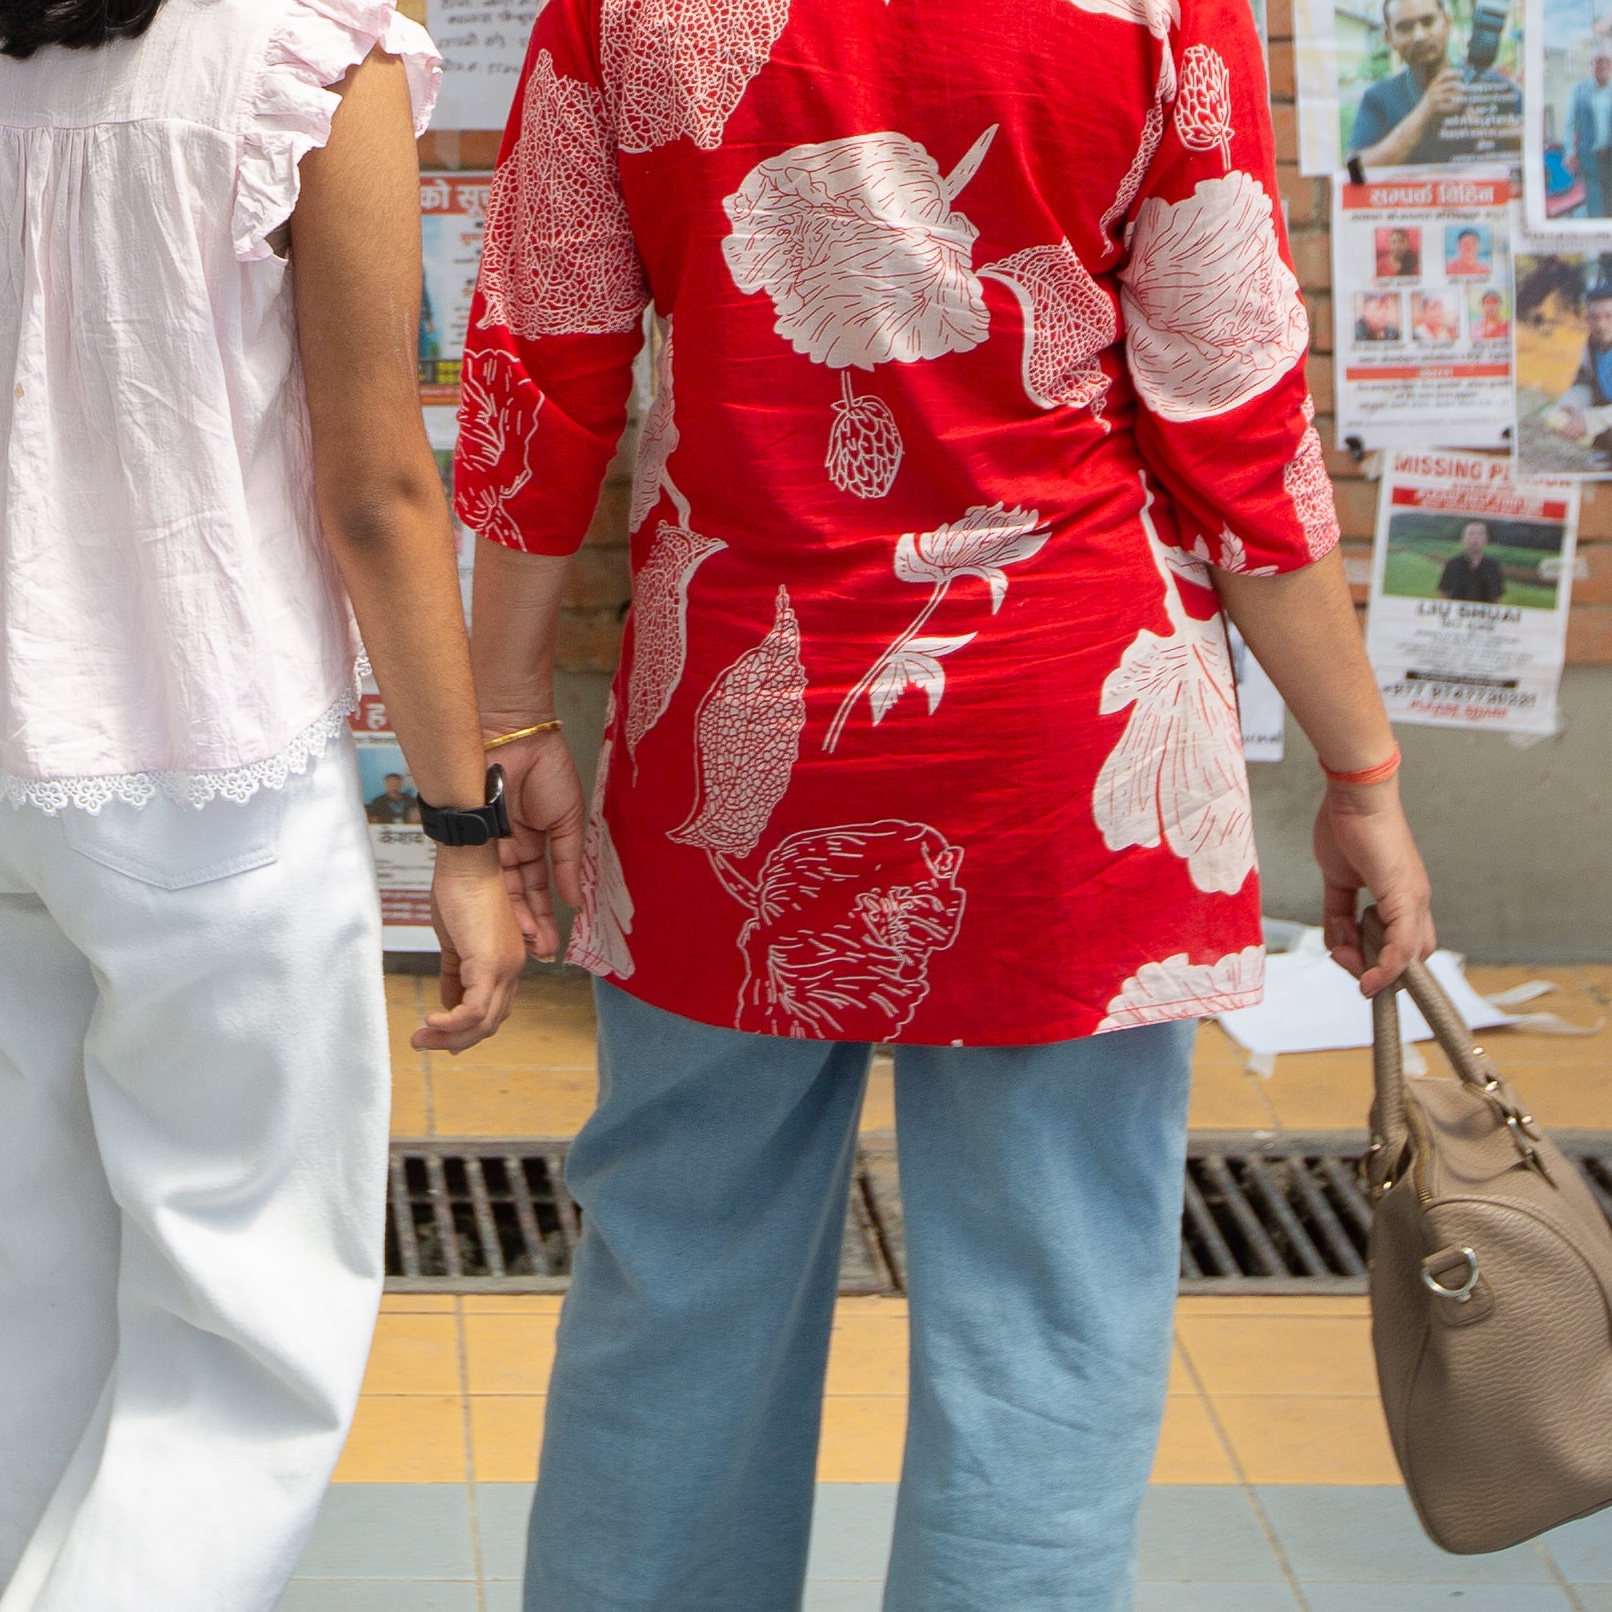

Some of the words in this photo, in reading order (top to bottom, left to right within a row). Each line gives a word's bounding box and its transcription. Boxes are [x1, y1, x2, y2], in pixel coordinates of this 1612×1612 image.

[1371, 182, 1433, 207] सम्पर्क
[1438, 178, 1494, 206] विहिन
[1393, 453, 1482, 479] MISSING
[1417, 602, 1452, 617] LIU
[1459, 605, 1522, 623] SHUAI
